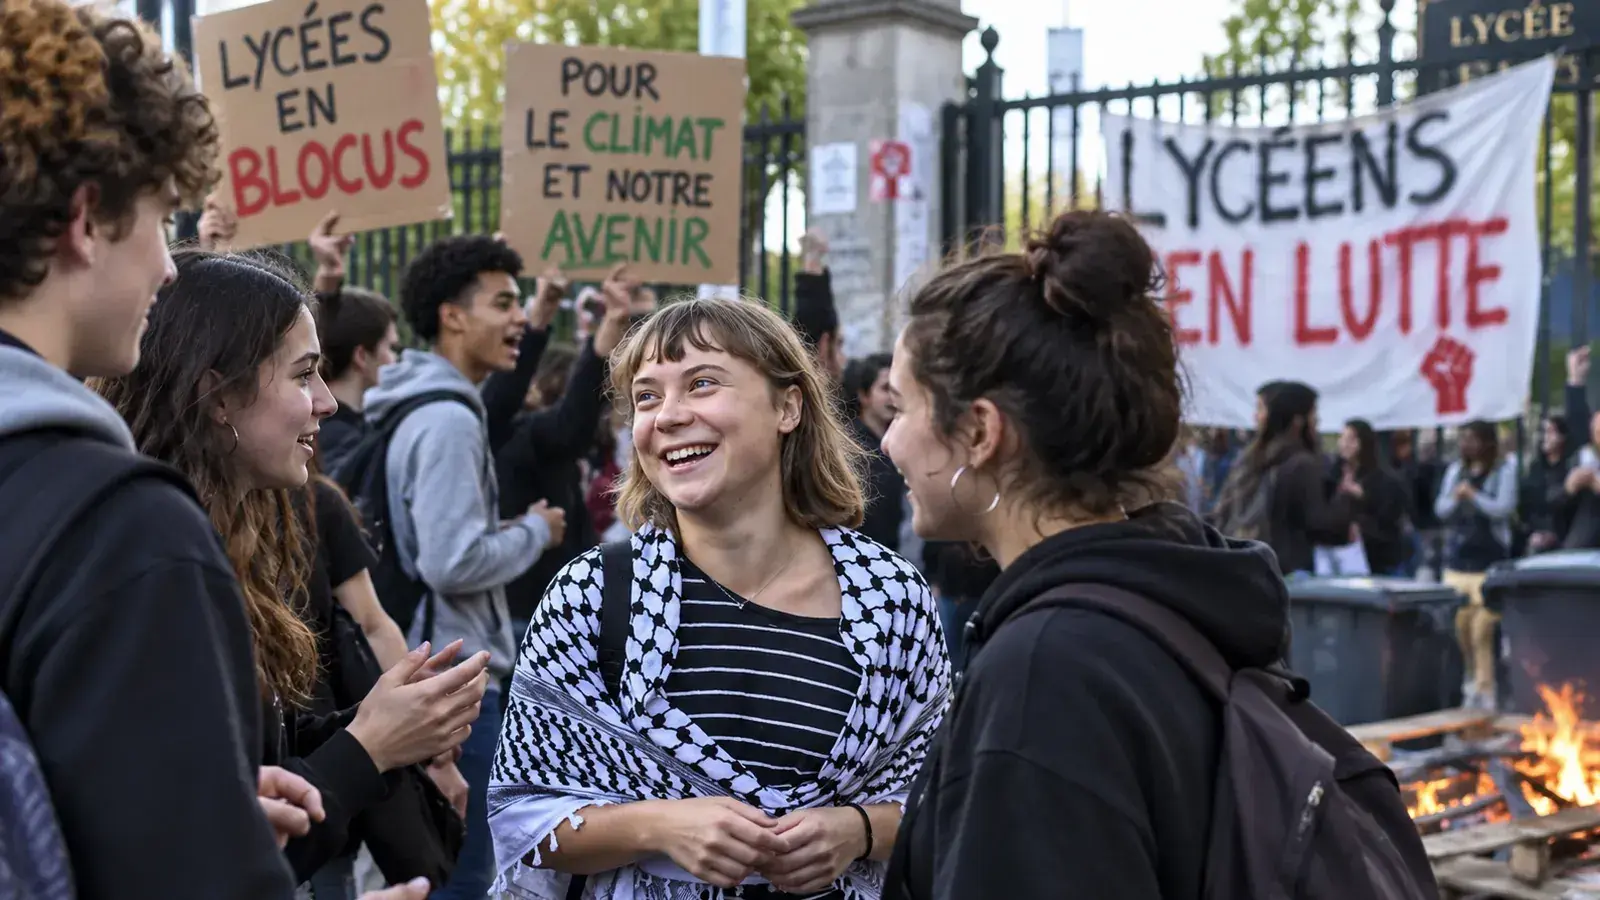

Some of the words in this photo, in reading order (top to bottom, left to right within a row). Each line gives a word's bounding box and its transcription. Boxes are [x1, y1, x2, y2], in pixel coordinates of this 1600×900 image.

[219, 1, 392, 90] LYCÉES
[1450, 1, 1575, 48] LYCÉE
[276, 83, 337, 133] EN
[561, 57, 660, 102] POUR
[525, 107, 571, 151] LE
[583, 106, 725, 161] CLIMAT
[228, 119, 430, 218] BLOCUS
[543, 163, 592, 199] ET
[606, 168, 714, 208] NOTRE
[1121, 110, 1459, 230] LYCÉENS
[541, 209, 712, 269] AVENIR
[1164, 246, 1255, 348] EN
[1294, 217, 1510, 345] LUTTE
